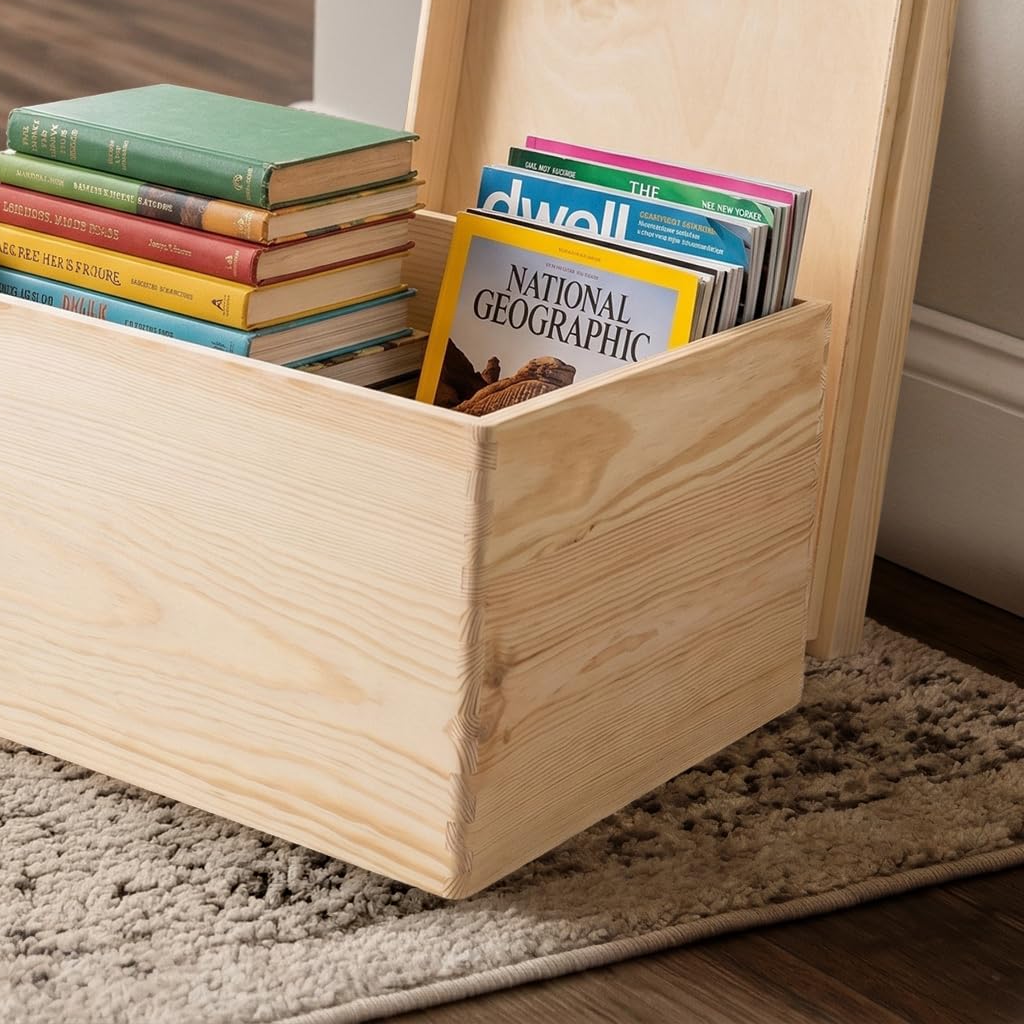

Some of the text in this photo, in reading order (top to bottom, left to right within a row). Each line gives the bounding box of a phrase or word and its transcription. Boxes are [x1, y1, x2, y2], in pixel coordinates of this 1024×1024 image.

[482, 178, 630, 240] dwell
[629, 180, 660, 198] THE
[717, 204, 735, 214] NEW
[735, 207, 762, 222] YORKER
[506, 264, 631, 324] NATIONAL
[473, 289, 651, 362] GEOGRAPHIC
